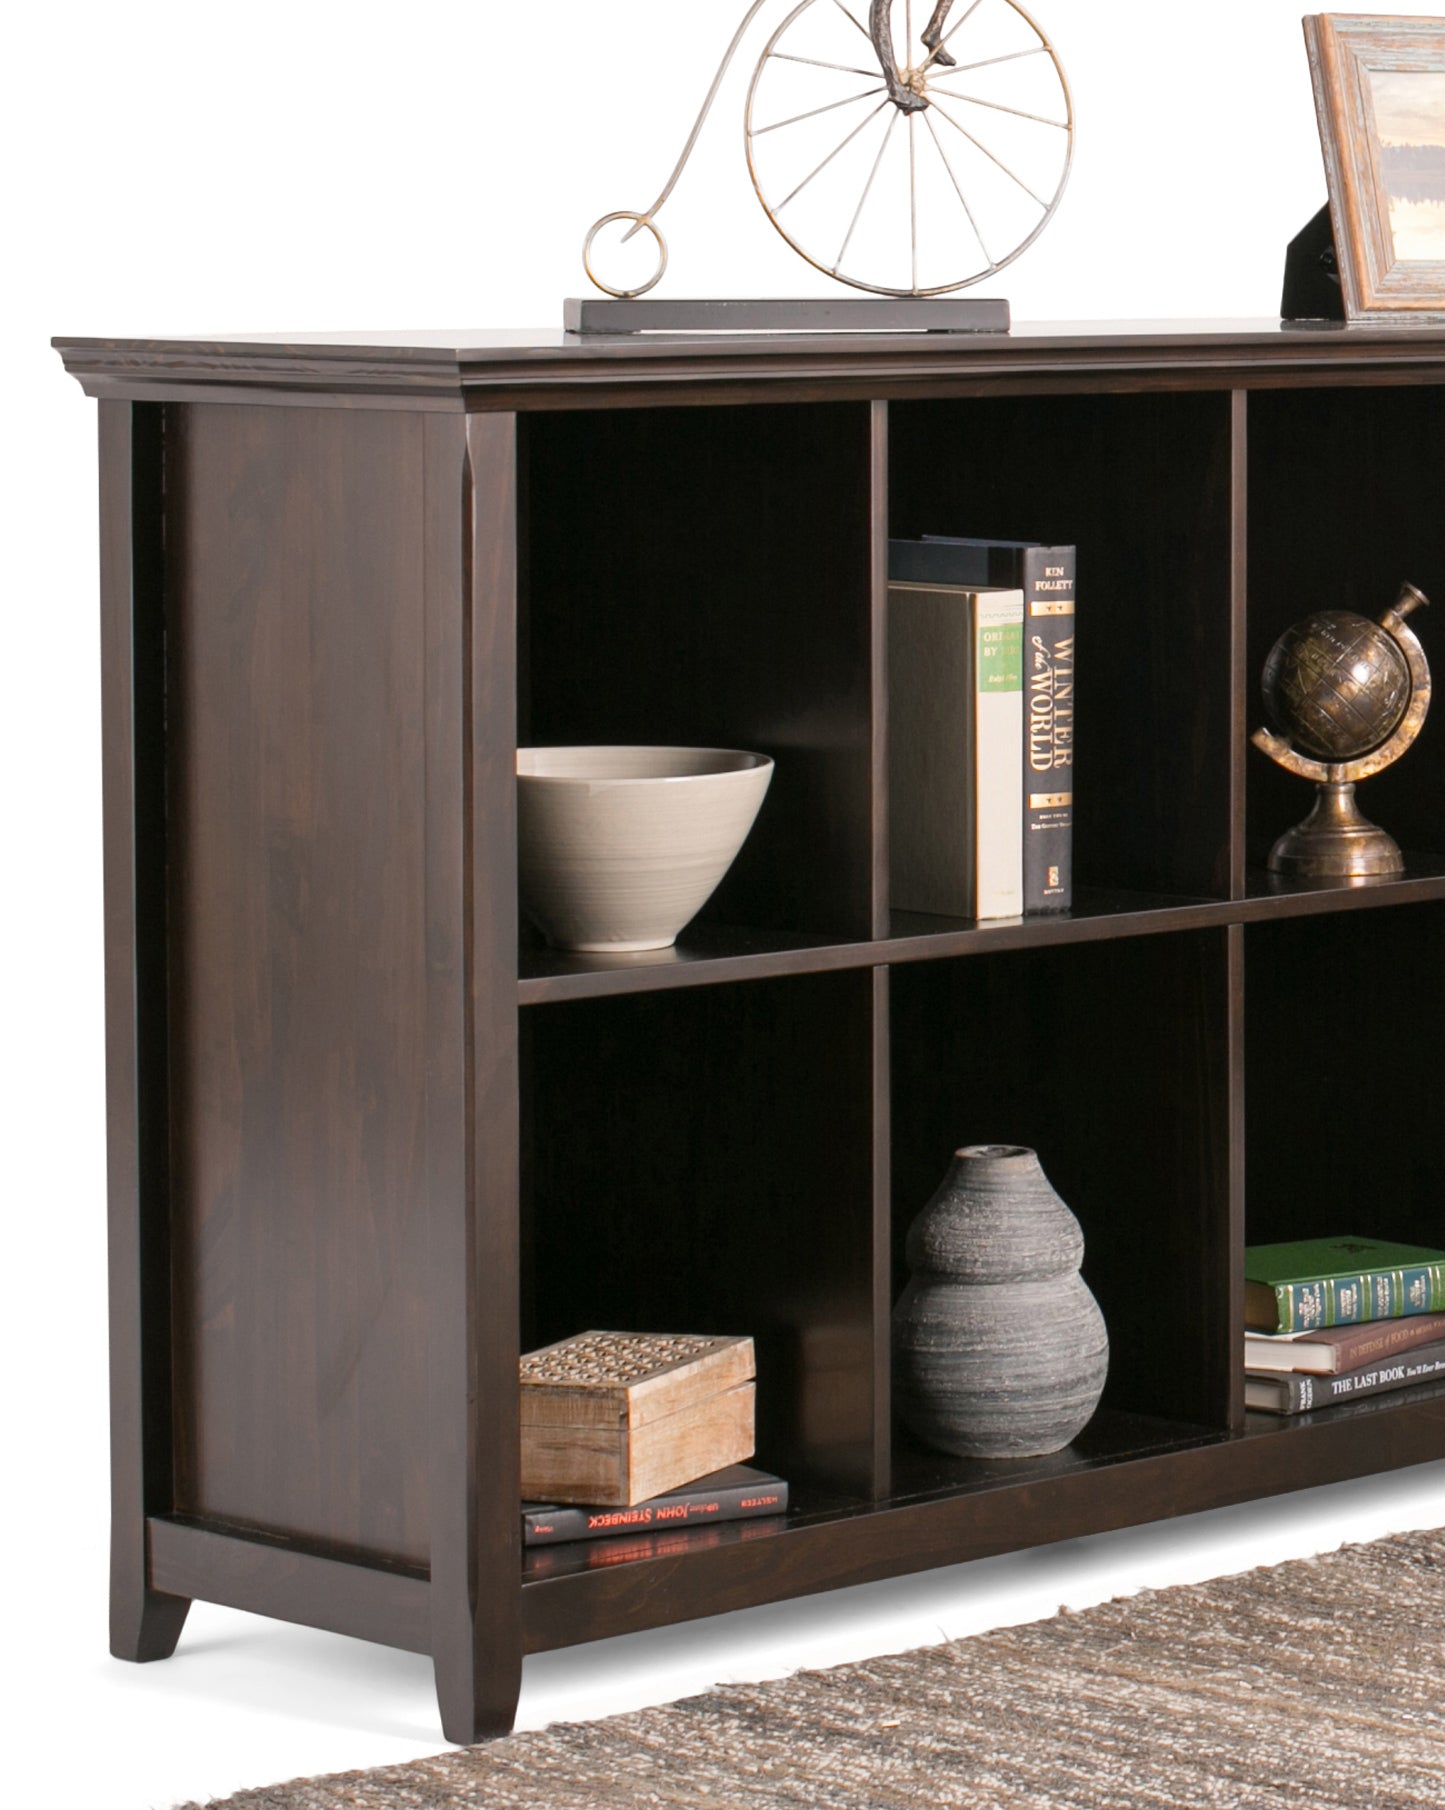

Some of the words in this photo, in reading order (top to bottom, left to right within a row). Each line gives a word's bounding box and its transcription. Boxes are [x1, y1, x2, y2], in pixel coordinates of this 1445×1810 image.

[1045, 566, 1064, 577] KEN
[1035, 580, 1073, 591] FOLLETT
[983, 646, 998, 657] BY
[1053, 637, 1074, 769] WINTER
[1030, 668, 1054, 771] WORLD
[1391, 1329, 1409, 1344] FOOD
[1331, 1378, 1353, 1395] THE
[1354, 1372, 1378, 1389] LAST
[1379, 1366, 1405, 1384] BOOK
[588, 1507, 652, 1528] STEINBECK
[656, 1502, 690, 1519] JOHN
